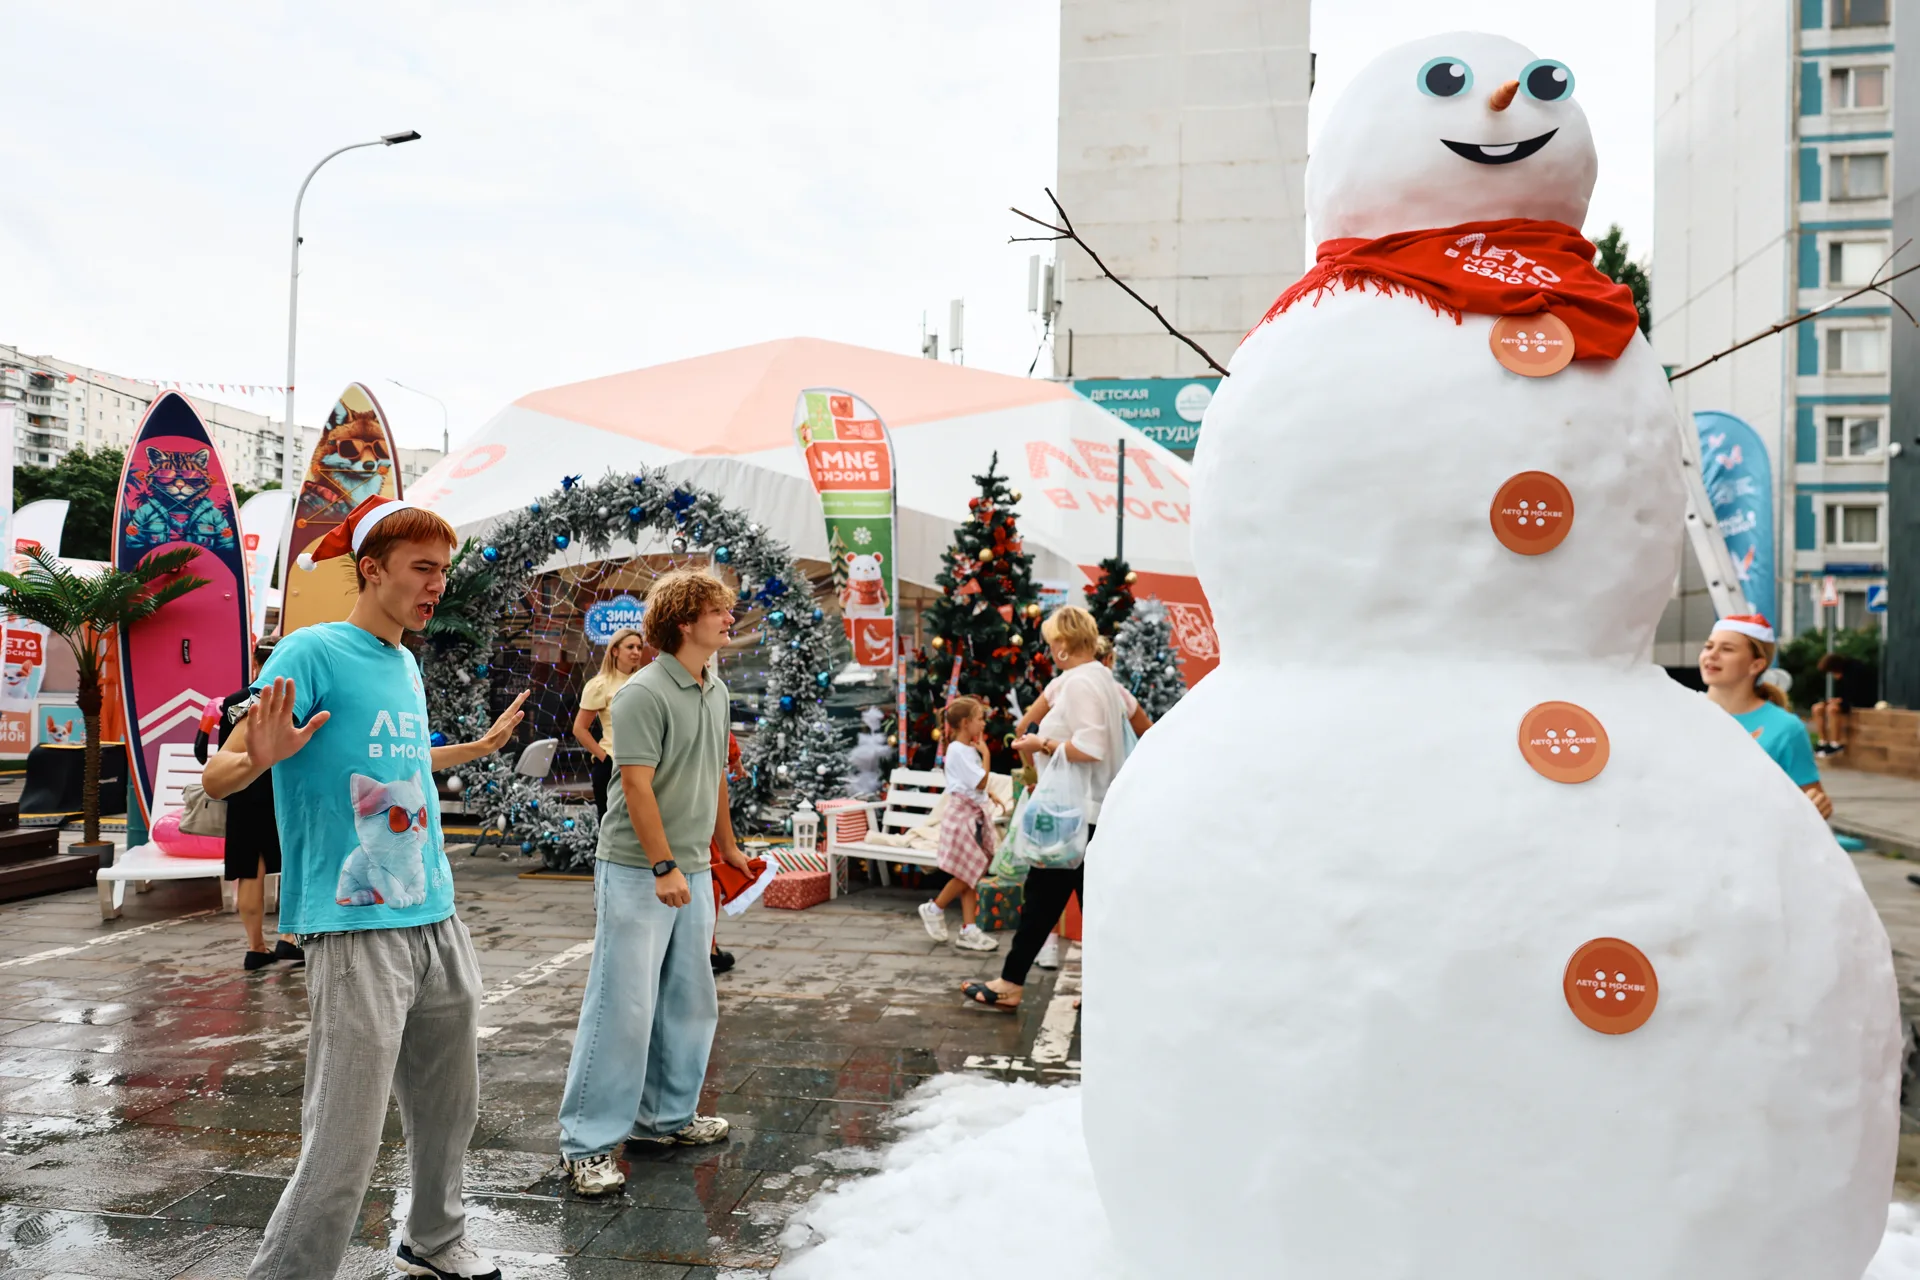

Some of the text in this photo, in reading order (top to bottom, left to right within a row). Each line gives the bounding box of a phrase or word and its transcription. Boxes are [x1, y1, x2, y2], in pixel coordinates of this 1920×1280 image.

[1444, 247, 1460, 258] В
[1455, 232, 1562, 283] ЛЕТО
[1500, 337, 1521, 345] ЛЕТО
[1530, 338, 1563, 346] МОСКВЕ
[1090, 388, 1149, 402] ДЕТСКАЯ
[1025, 438, 1190, 490] ЛЕТ
[1043, 487, 1081, 511] В
[1501, 508, 1522, 516] ЛЕТО
[1530, 510, 1563, 518] МОСКВЕ
[605, 610, 643, 622] ЗИМА
[600, 622, 608, 632] В
[1530, 738, 1552, 746] ЛЕТО
[1561, 737, 1597, 745] МОСКВЕ
[368, 743, 383, 758] В
[1576, 979, 1599, 988] ЛЕТО
[1608, 982, 1646, 992] МОСКВЕ
